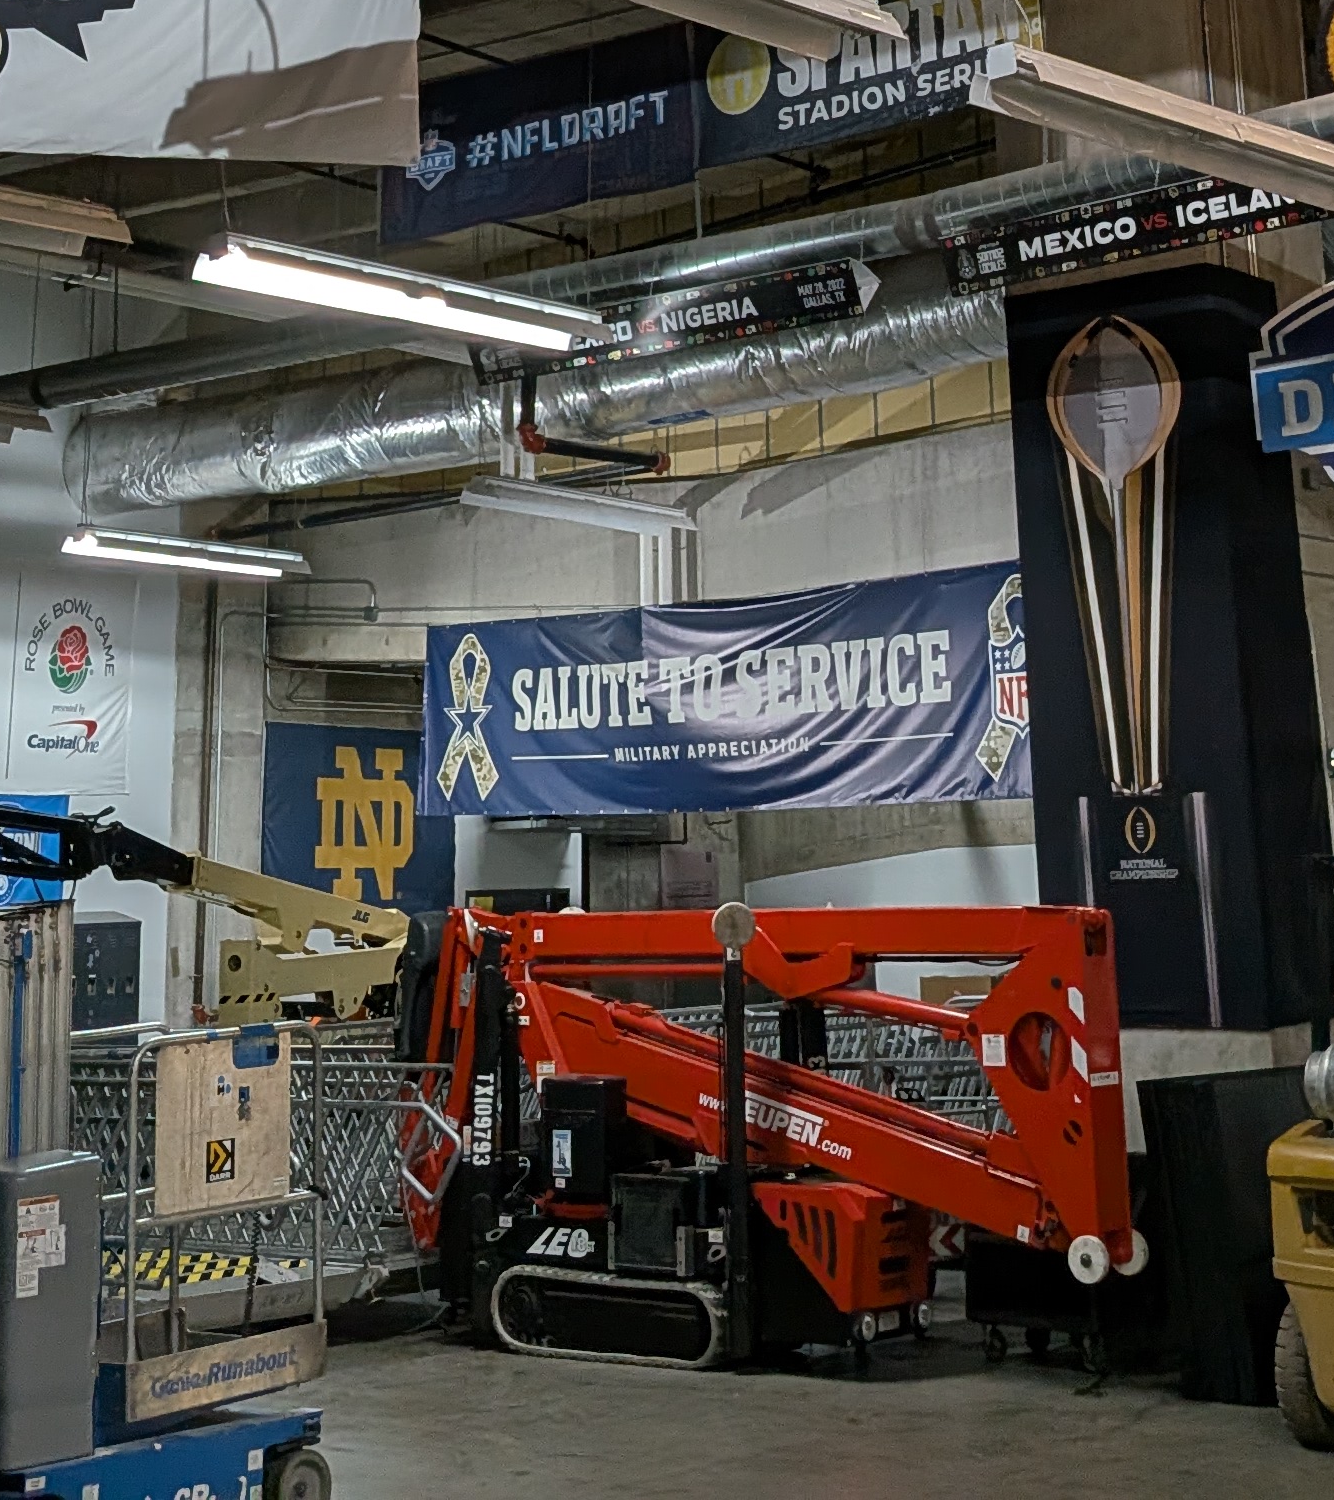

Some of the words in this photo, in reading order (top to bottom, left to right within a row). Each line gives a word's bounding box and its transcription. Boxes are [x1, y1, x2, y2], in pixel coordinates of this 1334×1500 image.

[778, 77, 906, 131] STADION
[467, 90, 669, 169] #NFLDRAFT
[1017, 216, 1137, 262] MEXICO
[1140, 212, 1173, 232] VS.
[660, 296, 759, 335] NIGERIA
[24, 612, 52, 672] ROSE
[52, 597, 94, 622] BOWL
[94, 616, 115, 677] GAME
[512, 660, 653, 732] SALUTE
[659, 653, 723, 724] TO
[735, 629, 953, 719] SERVICE
[996, 674, 1029, 722] NF
[614, 744, 680, 763] MILITARY
[687, 737, 810, 760] APPRECIATION
[207, 1344, 298, 1386] Runabout
